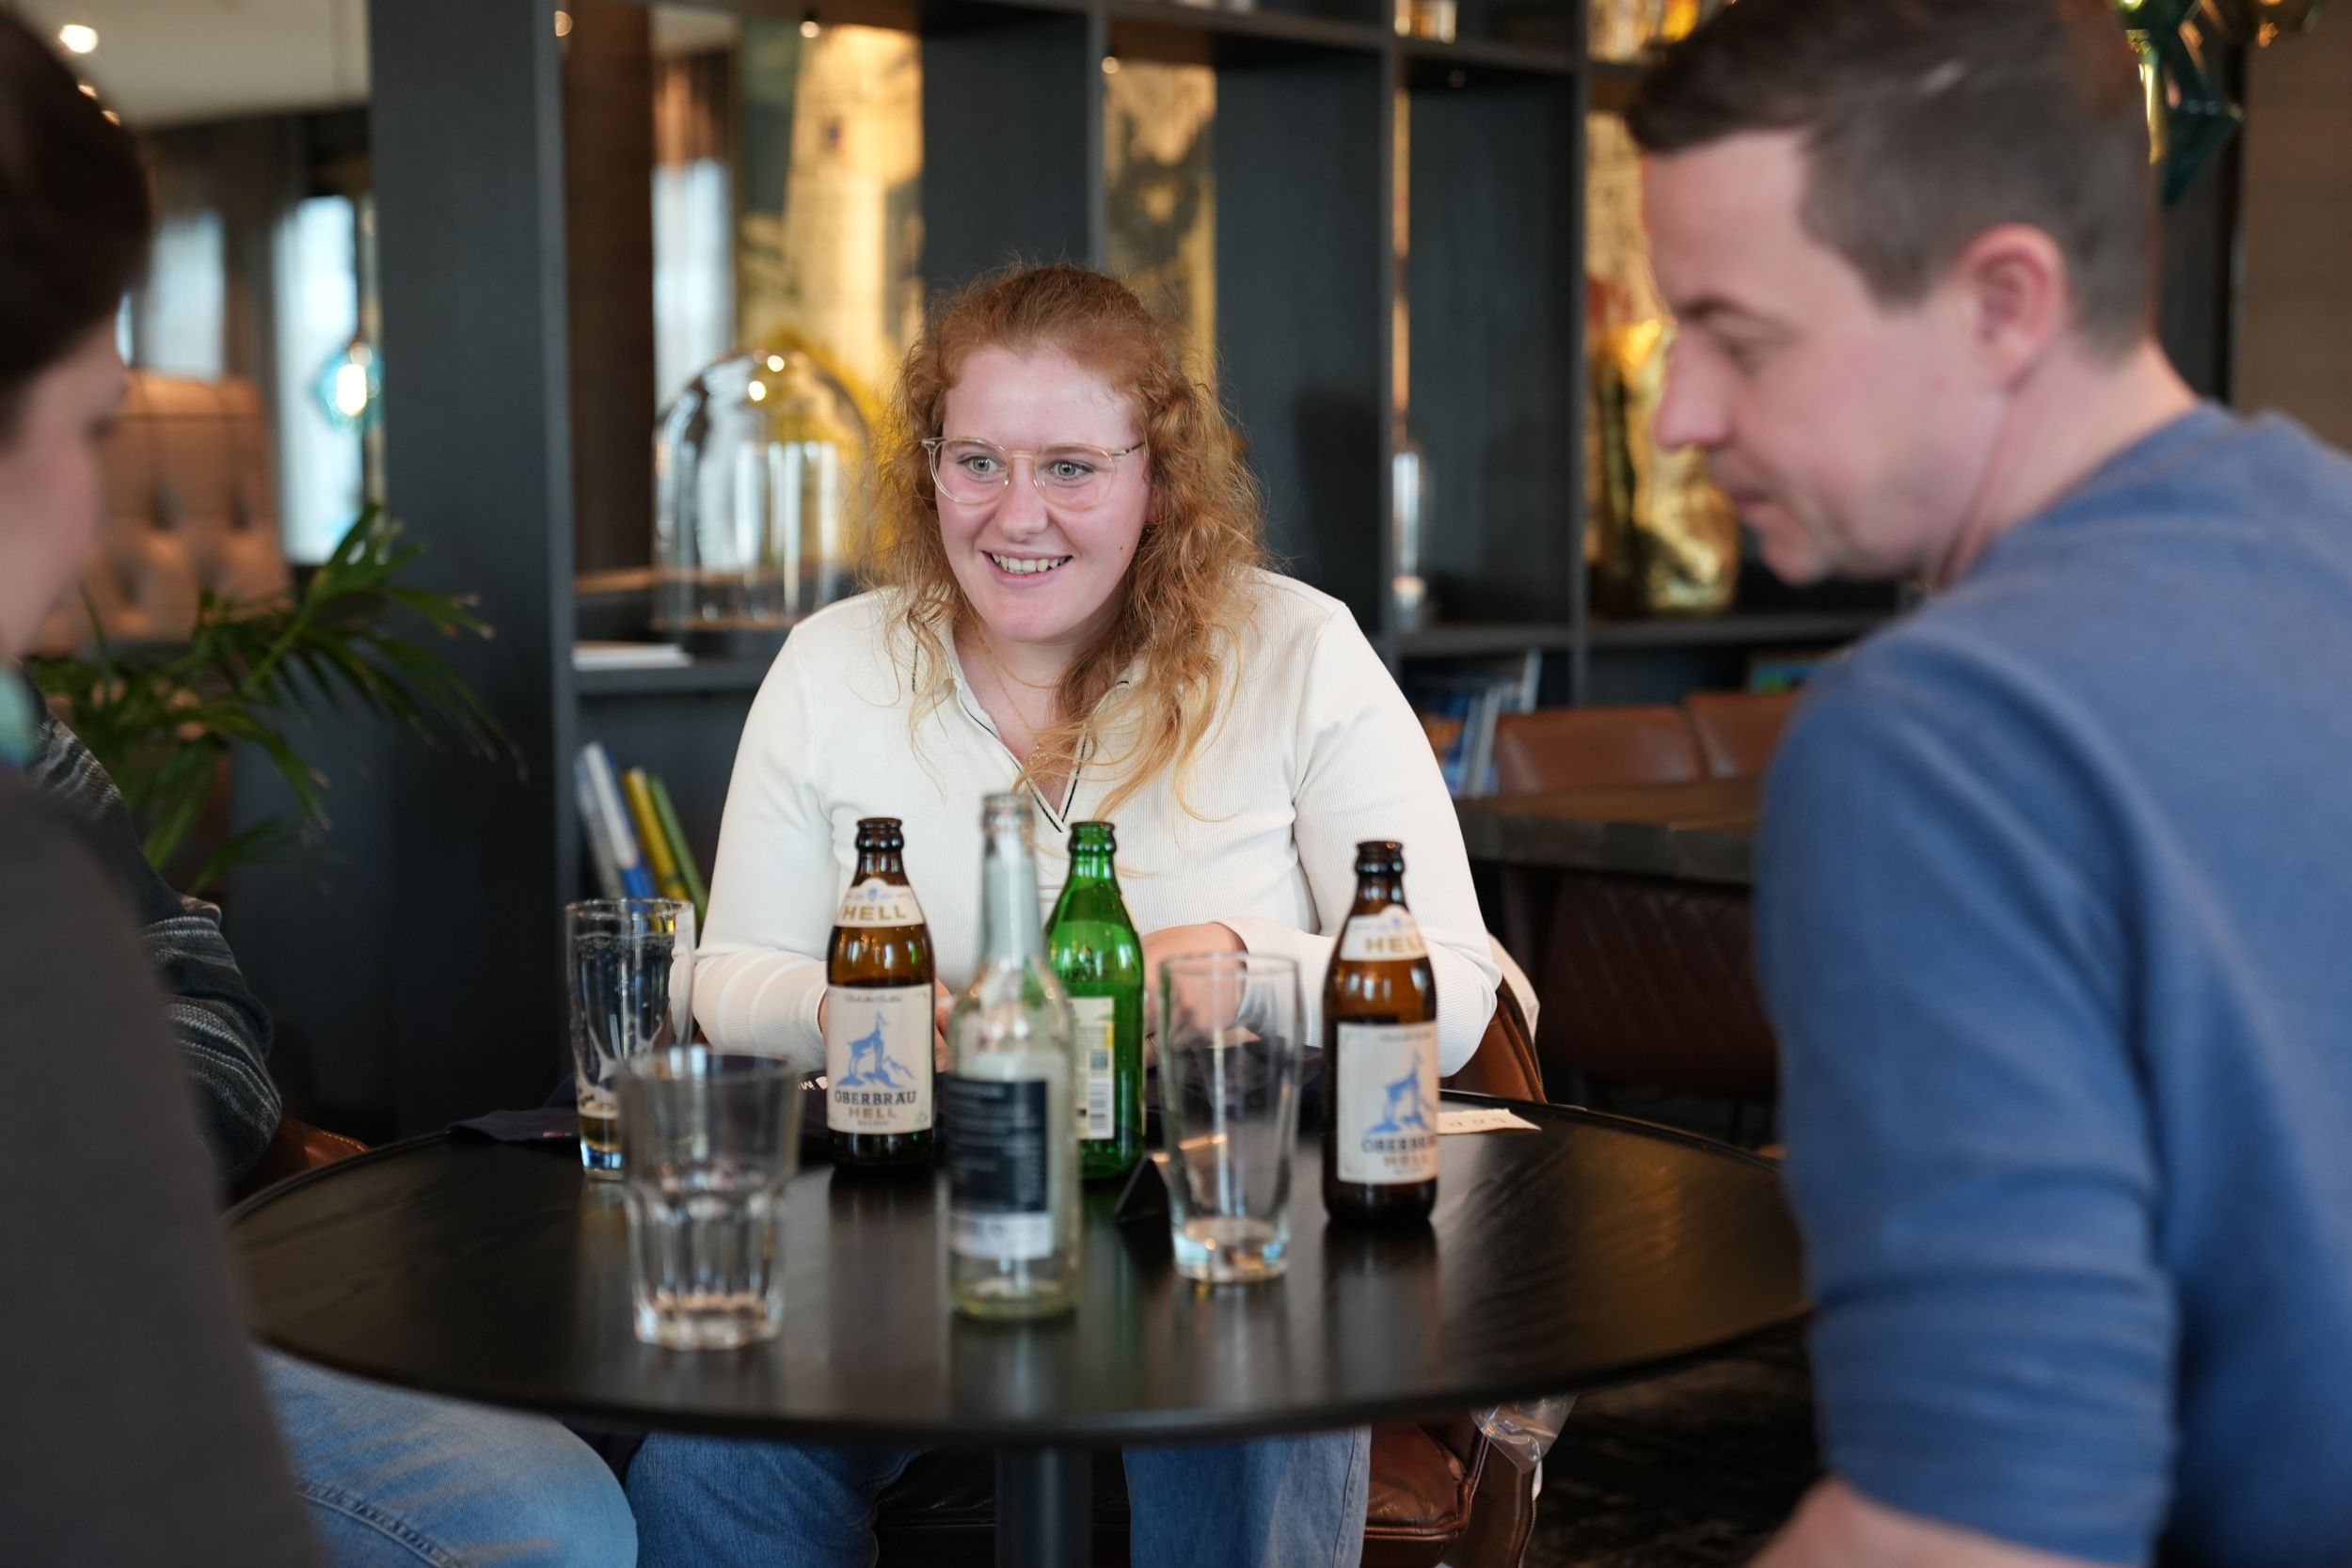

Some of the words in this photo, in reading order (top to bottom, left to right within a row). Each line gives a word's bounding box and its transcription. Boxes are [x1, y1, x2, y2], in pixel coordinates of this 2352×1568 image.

[841, 903, 908, 921] HELL
[834, 1089, 917, 1106] OBERBRÄU
[849, 1106, 898, 1119] HELL
